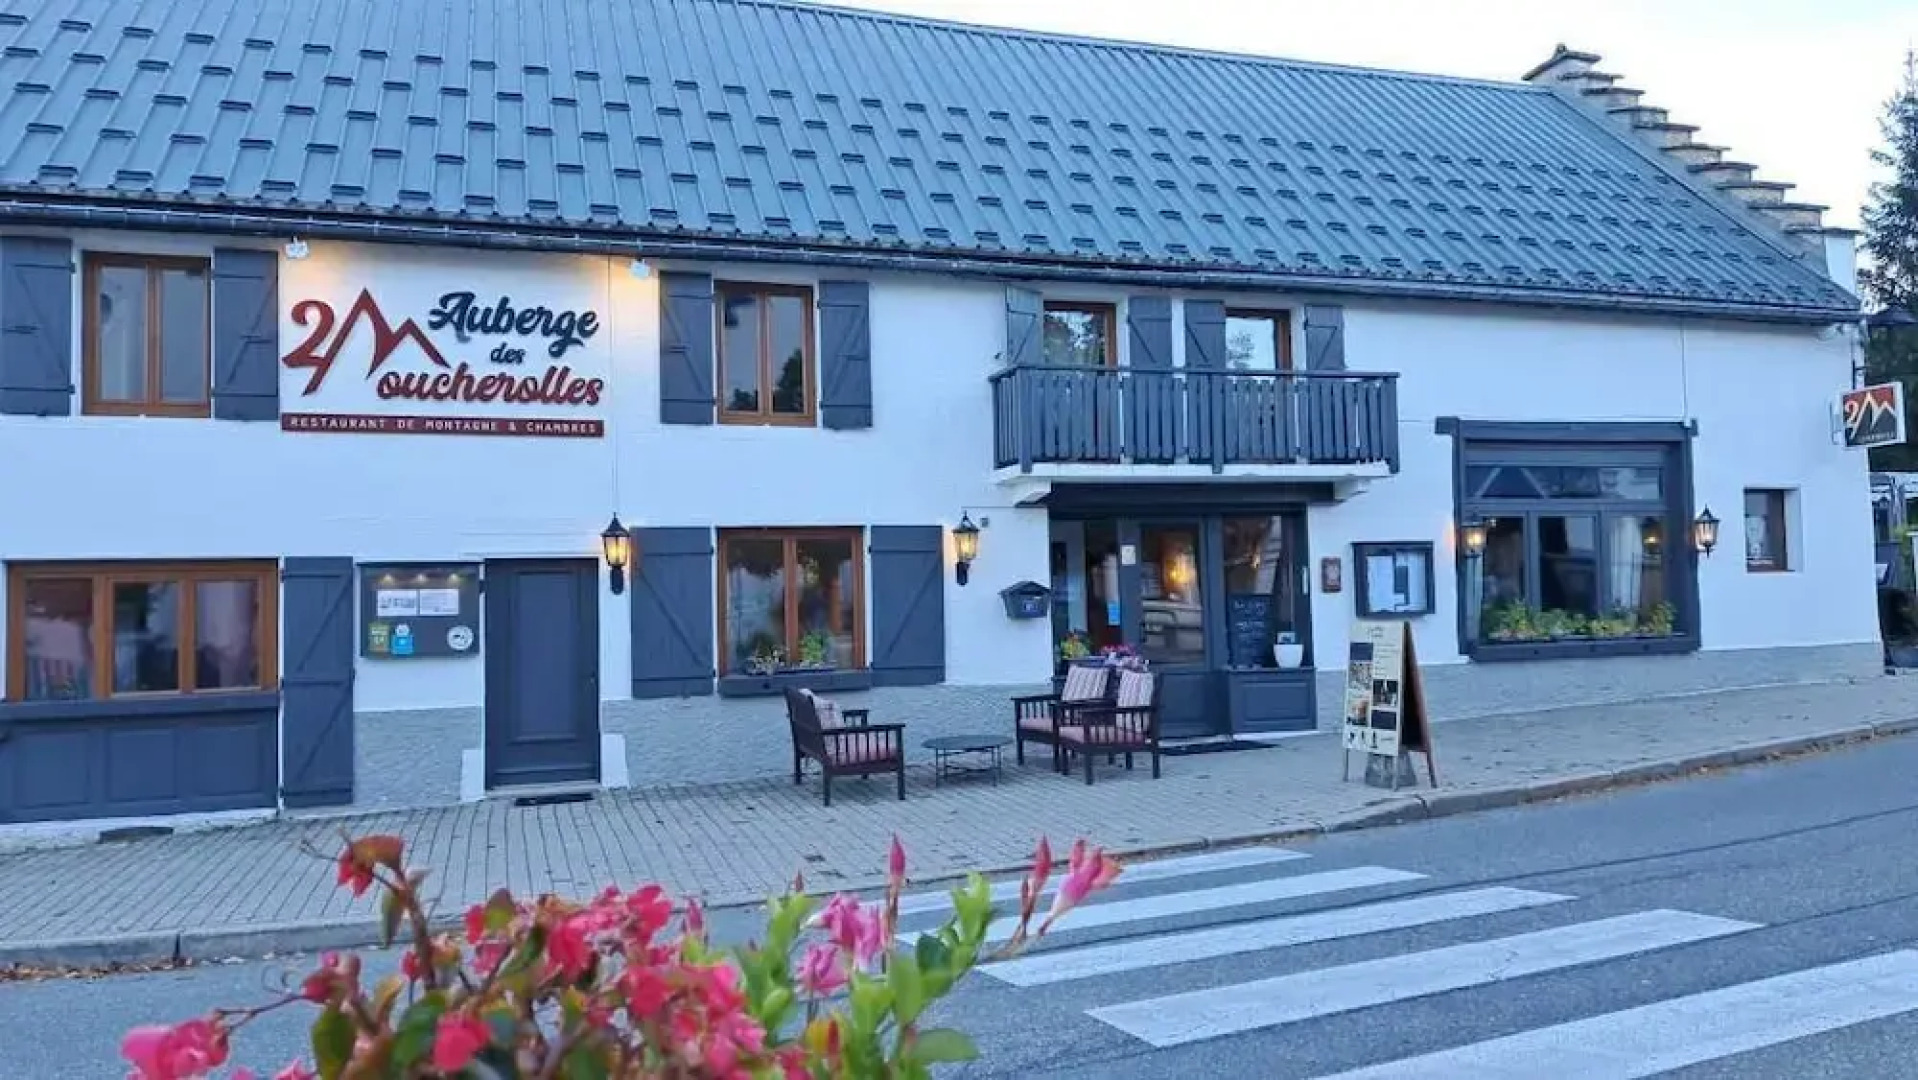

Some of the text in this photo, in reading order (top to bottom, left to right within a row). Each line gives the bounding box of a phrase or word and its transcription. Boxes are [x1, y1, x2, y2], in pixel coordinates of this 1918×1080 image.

[427, 291, 600, 358] Auberge
[490, 342, 525, 365] des
[290, 417, 597, 433] RESTAURANT DE MONTAGNE & CHAMBRES
